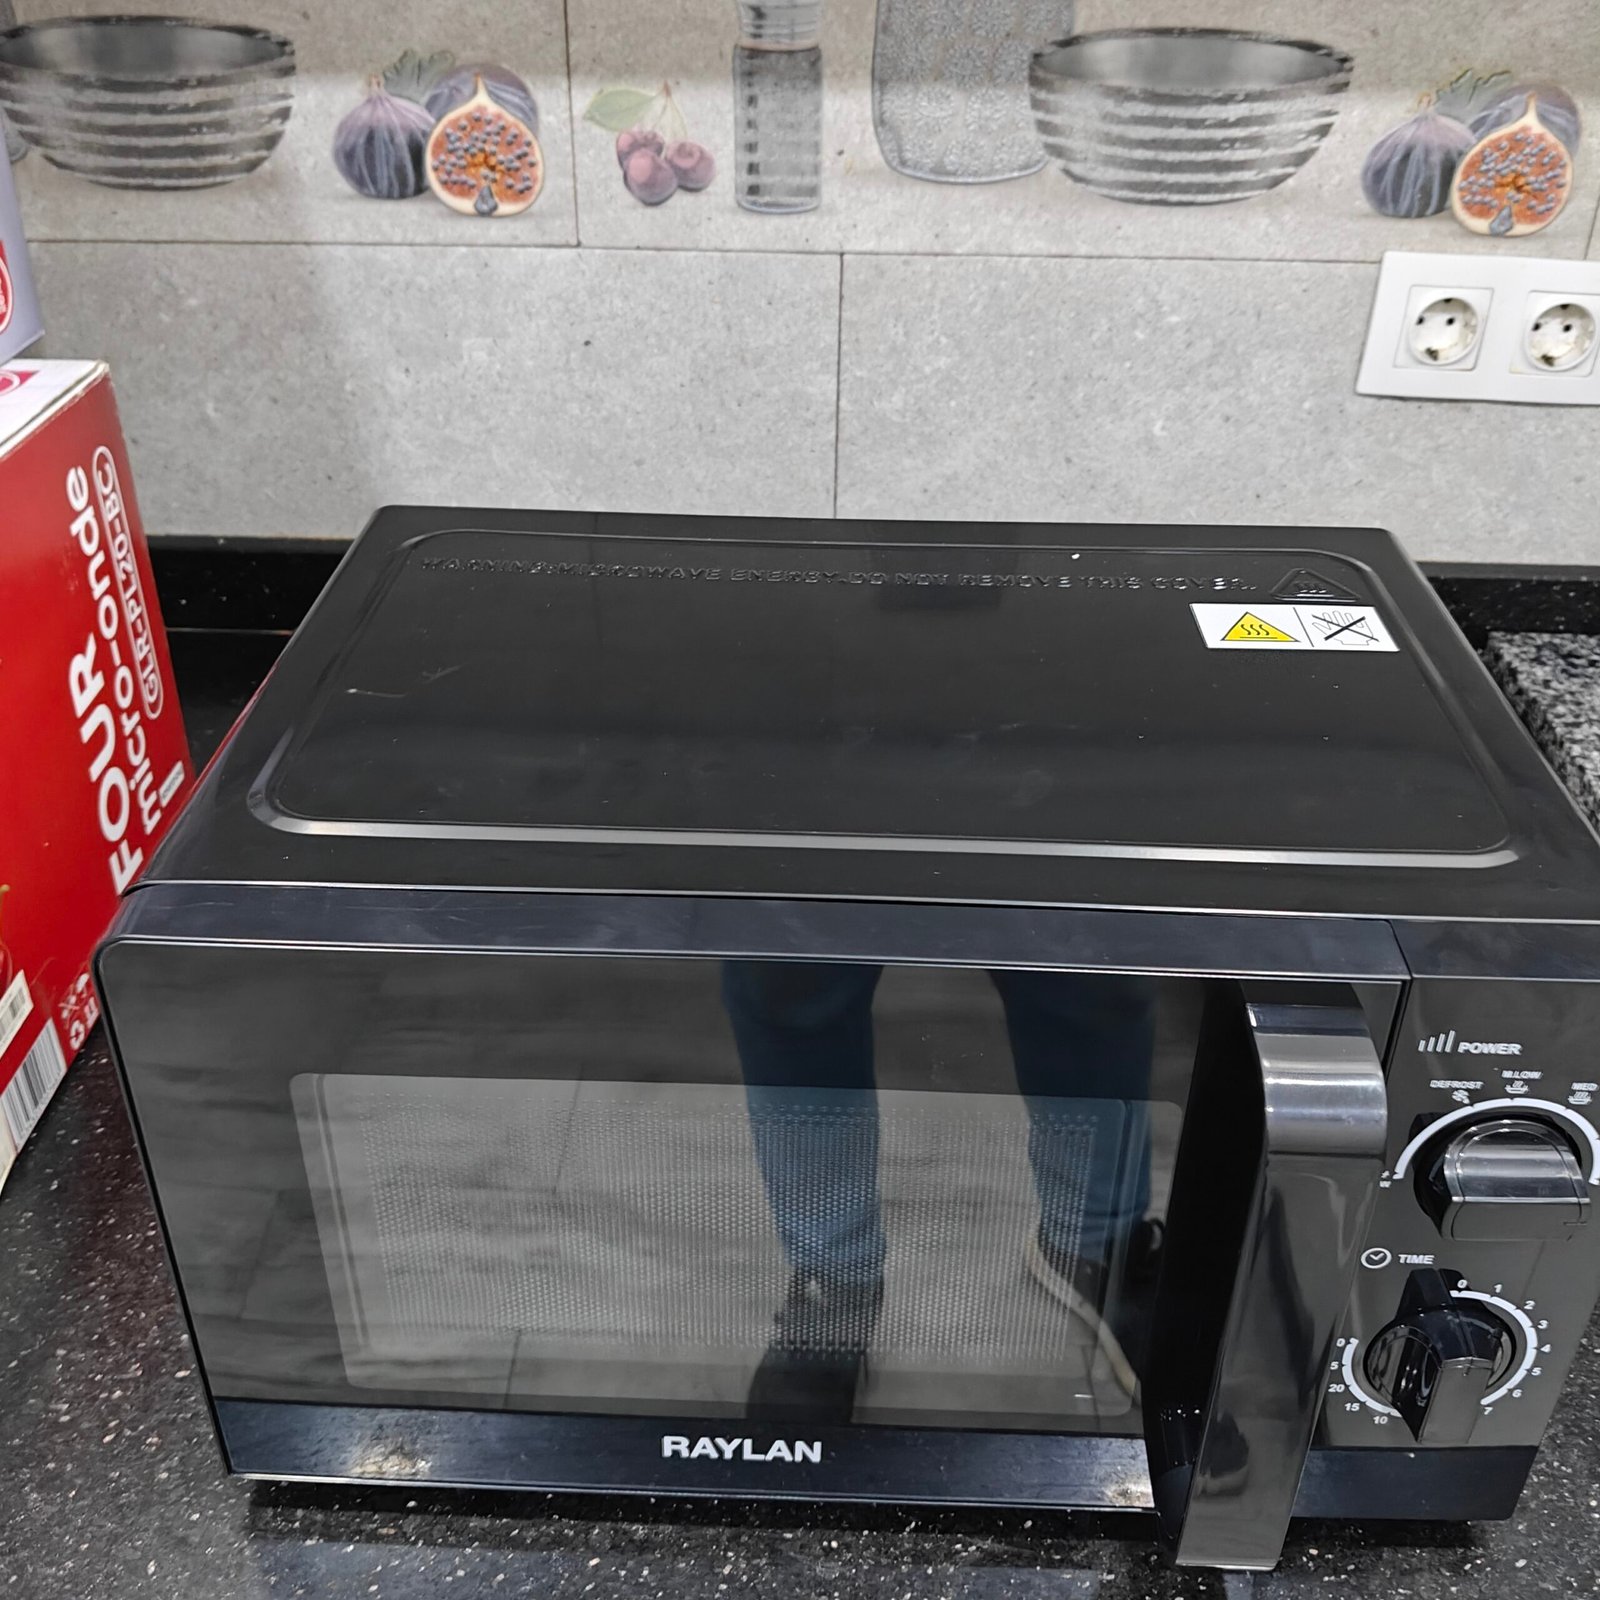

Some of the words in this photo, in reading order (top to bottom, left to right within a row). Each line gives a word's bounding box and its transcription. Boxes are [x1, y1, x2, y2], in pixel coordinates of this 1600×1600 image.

[958, 573, 1073, 588] REMOVE
[66, 465, 163, 835] micro-onde
[69, 632, 144, 896] FOUR
[1457, 1041, 1523, 1056] POWER
[1430, 1080, 1484, 1090] DEFROST
[1398, 1253, 1435, 1265] TIME
[1456, 1279, 1468, 1289] 0
[1493, 1284, 1502, 1293] 1
[1523, 1300, 1535, 1310] 2
[1537, 1319, 1549, 1329] 3
[1540, 1343, 1551, 1353] 4
[1530, 1367, 1542, 1376] 5
[1327, 1383, 1345, 1393] 20
[1512, 1388, 1522, 1398] 6
[1344, 1402, 1360, 1412] 15
[1483, 1406, 1493, 1416] 7
[1372, 1415, 1388, 1425] 10
[661, 1435, 823, 1464] RAYLAN
